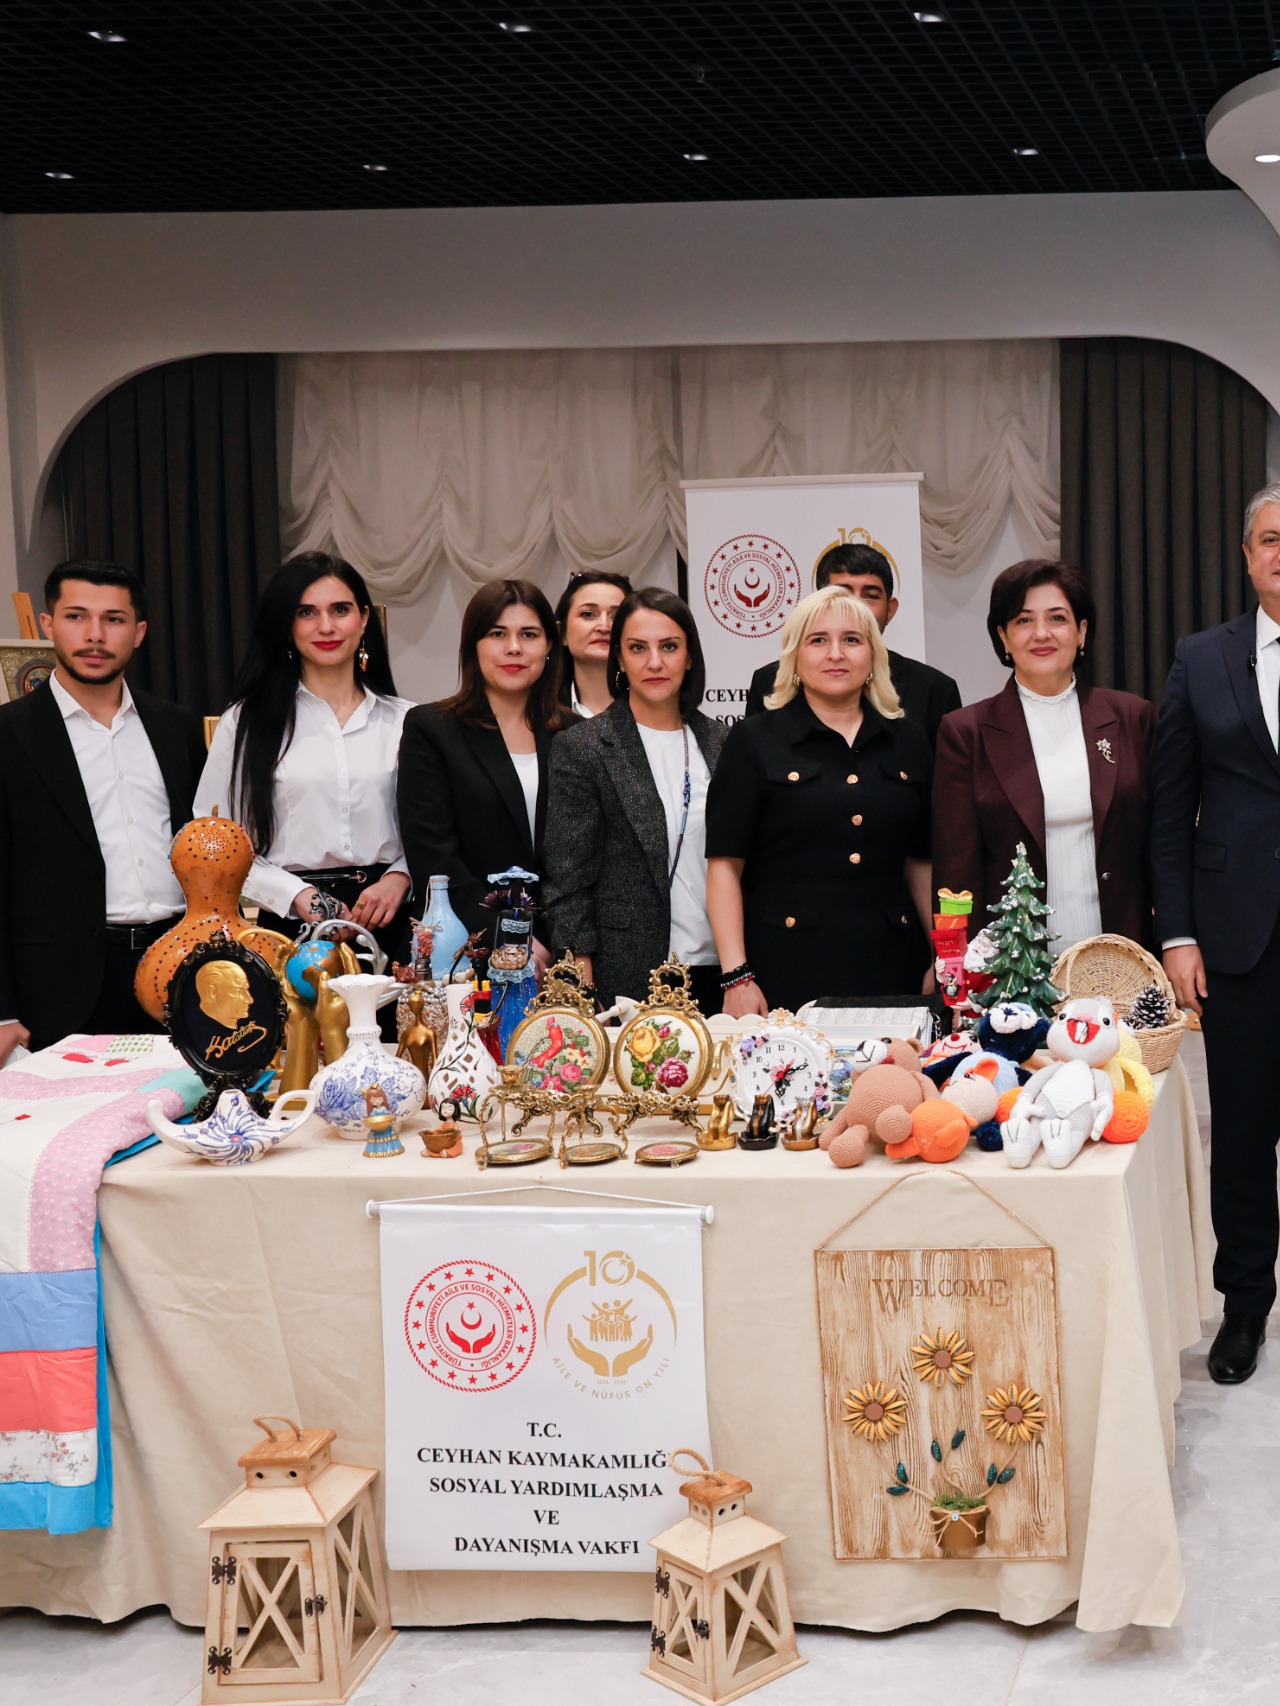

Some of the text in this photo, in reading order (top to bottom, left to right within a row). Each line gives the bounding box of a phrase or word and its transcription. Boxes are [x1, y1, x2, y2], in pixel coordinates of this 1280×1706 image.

[751, 552, 771, 565] SOSYAL
[584, 1250, 636, 1286] 10
[871, 1278, 1010, 1314] WELCOME
[428, 1283, 514, 1368] TÜRKİYE CUMHURİYETİ AİLE VE SOSYAL HİZMETLER BAKANLIĞI
[552, 1356, 572, 1381] AİLE
[574, 1380, 588, 1393] VE
[591, 1389, 631, 1400] NÜFUS
[635, 1380, 652, 1394] ON
[653, 1357, 671, 1379] YILI
[526, 1422, 562, 1438] T.C.
[416, 1447, 502, 1465] CEYHAN
[429, 1477, 664, 1501] SOSYAL YARDIMLAŞMA
[533, 1509, 560, 1525] VE
[454, 1536, 640, 1556] DAYANIŞMA VAKFI
